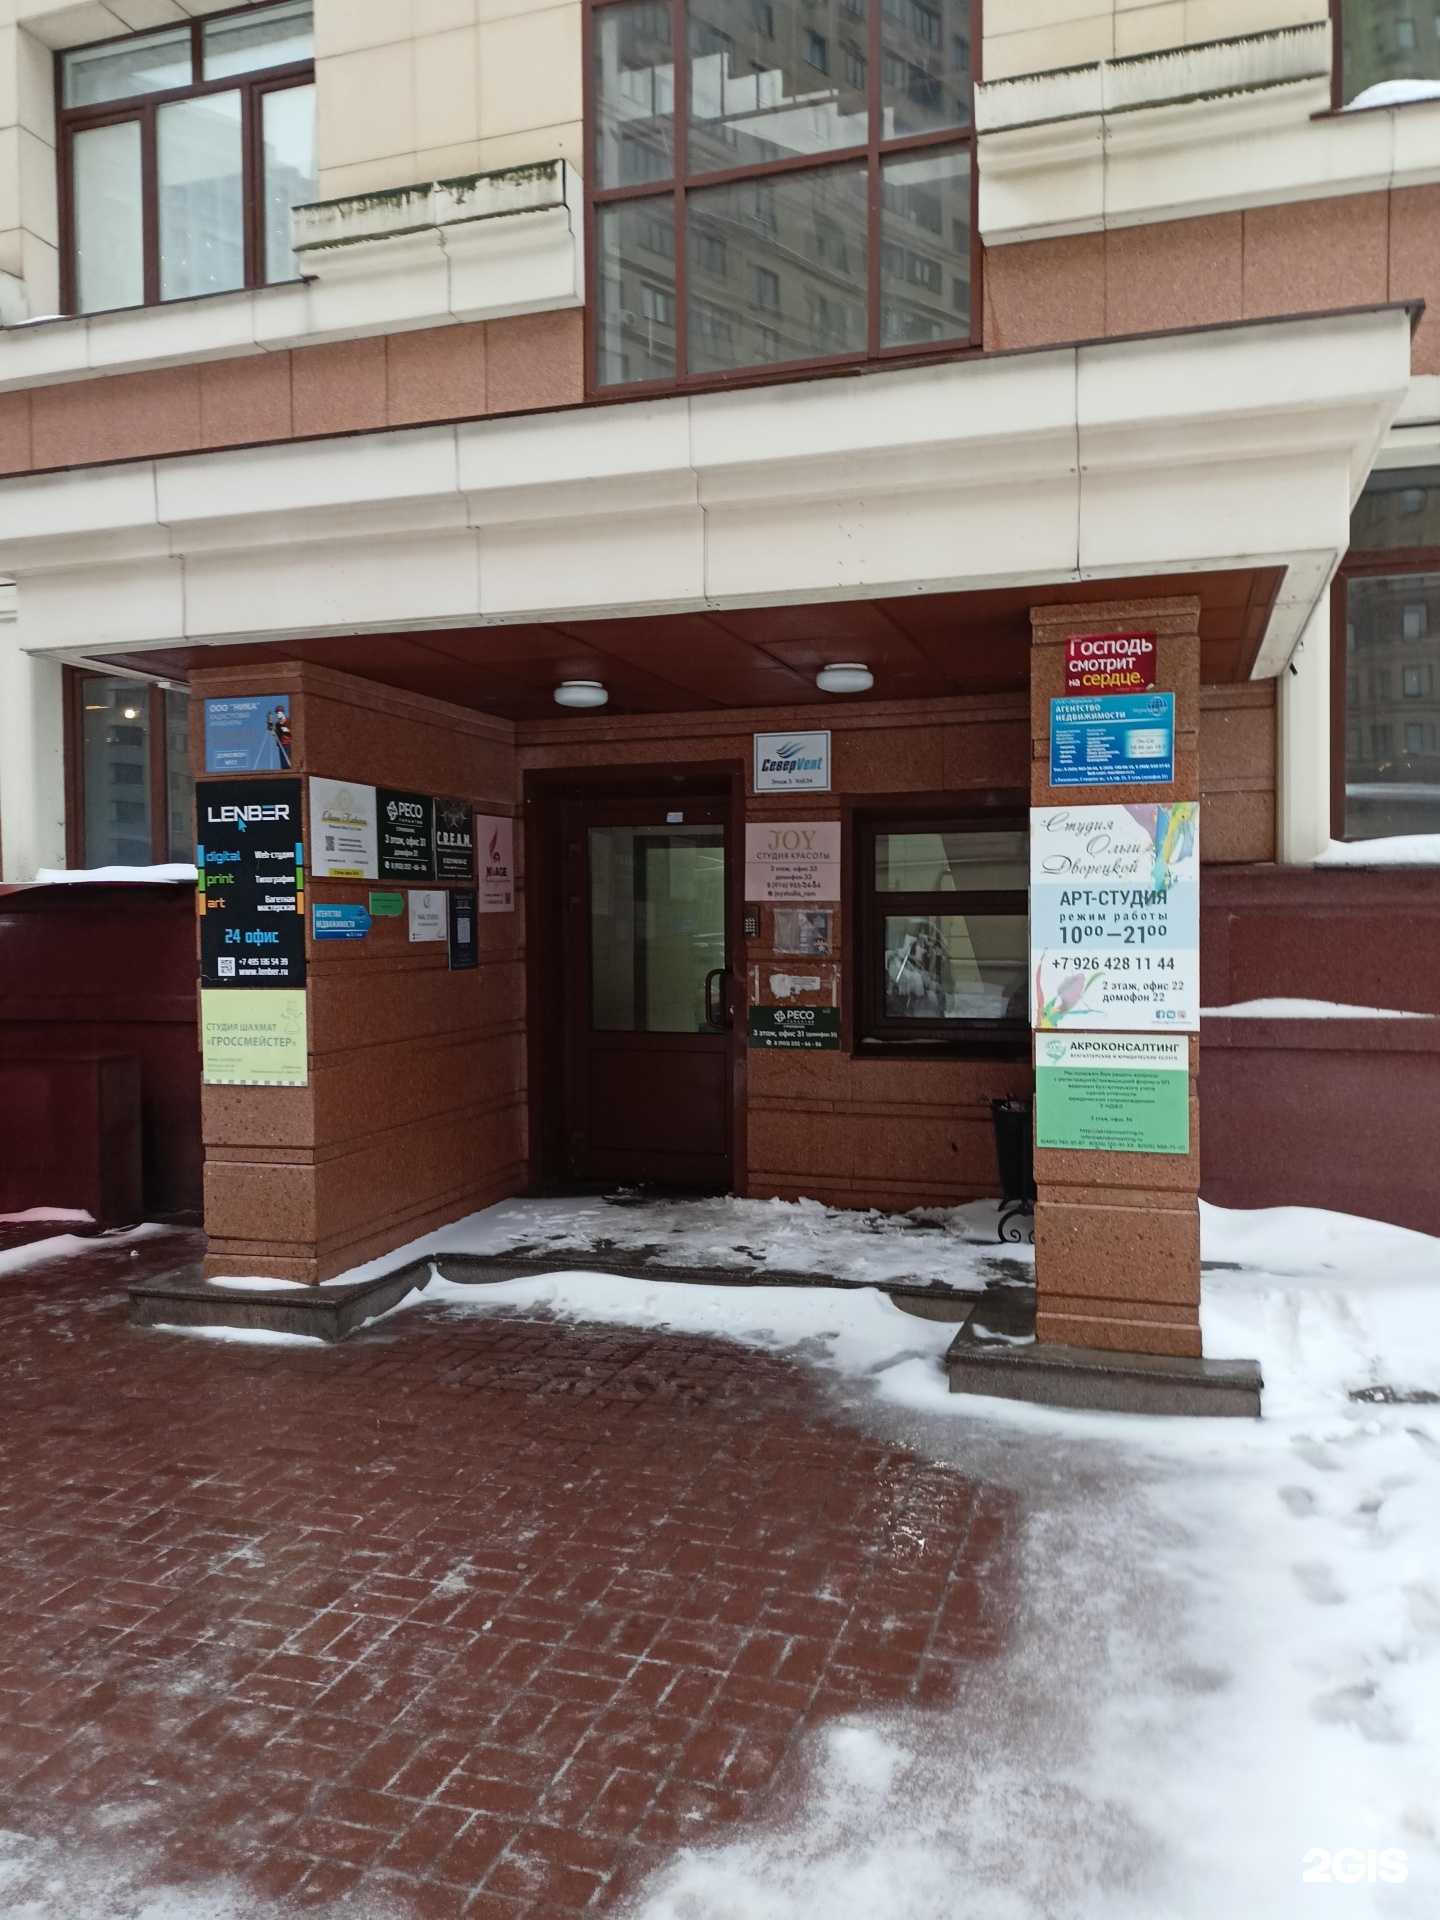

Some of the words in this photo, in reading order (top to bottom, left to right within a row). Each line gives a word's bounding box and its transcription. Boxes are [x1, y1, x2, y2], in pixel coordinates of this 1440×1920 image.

[1069, 637, 1153, 656] Господь
[1069, 657, 1136, 673] смотрит
[1069, 678, 1080, 687] на
[1082, 671, 1144, 688] сердце.
[1055, 703, 1101, 713] АГЕНТСТВО
[1055, 711, 1126, 722] НЕДВИЖИМОСТИ
[207, 804, 290, 823] LENBER
[399, 802, 423, 818] РЕСО
[1041, 811, 1114, 837] Студия
[768, 830, 816, 850] JOY
[1086, 833, 1149, 856] Ольги
[206, 851, 241, 864] digital
[756, 852, 790, 860] СТУДИЯ
[1041, 854, 1138, 879] Дворецкой
[207, 873, 235, 887] print
[207, 897, 226, 908] art
[1059, 889, 1168, 908] АРТ-СТУДИЯ
[1059, 912, 1106, 924] режим
[1114, 911, 1168, 923] работы
[224, 928, 241, 944] 24
[244, 928, 280, 946] офис
[238, 958, 247, 966] +7
[248, 958, 260, 966] 495
[1052, 957, 1067, 970] +7
[1073, 957, 1099, 970] 926
[1104, 957, 1130, 970] 428
[1137, 957, 1151, 970] 11
[1157, 957, 1175, 970] 44
[1102, 981, 1108, 990] 2
[1110, 982, 1140, 992] этаж,
[1143, 980, 1169, 993] офис
[1171, 981, 1184, 990] 22
[1102, 992, 1150, 1004] домофон
[1152, 992, 1165, 1002] 22
[786, 1010, 815, 1020] РЕСО
[206, 1022, 239, 1032] СТУДИЯ
[240, 1023, 277, 1032] ШАХМАТ
[1070, 1041, 1180, 1053] АКРОКОНСАЛТИНГ
